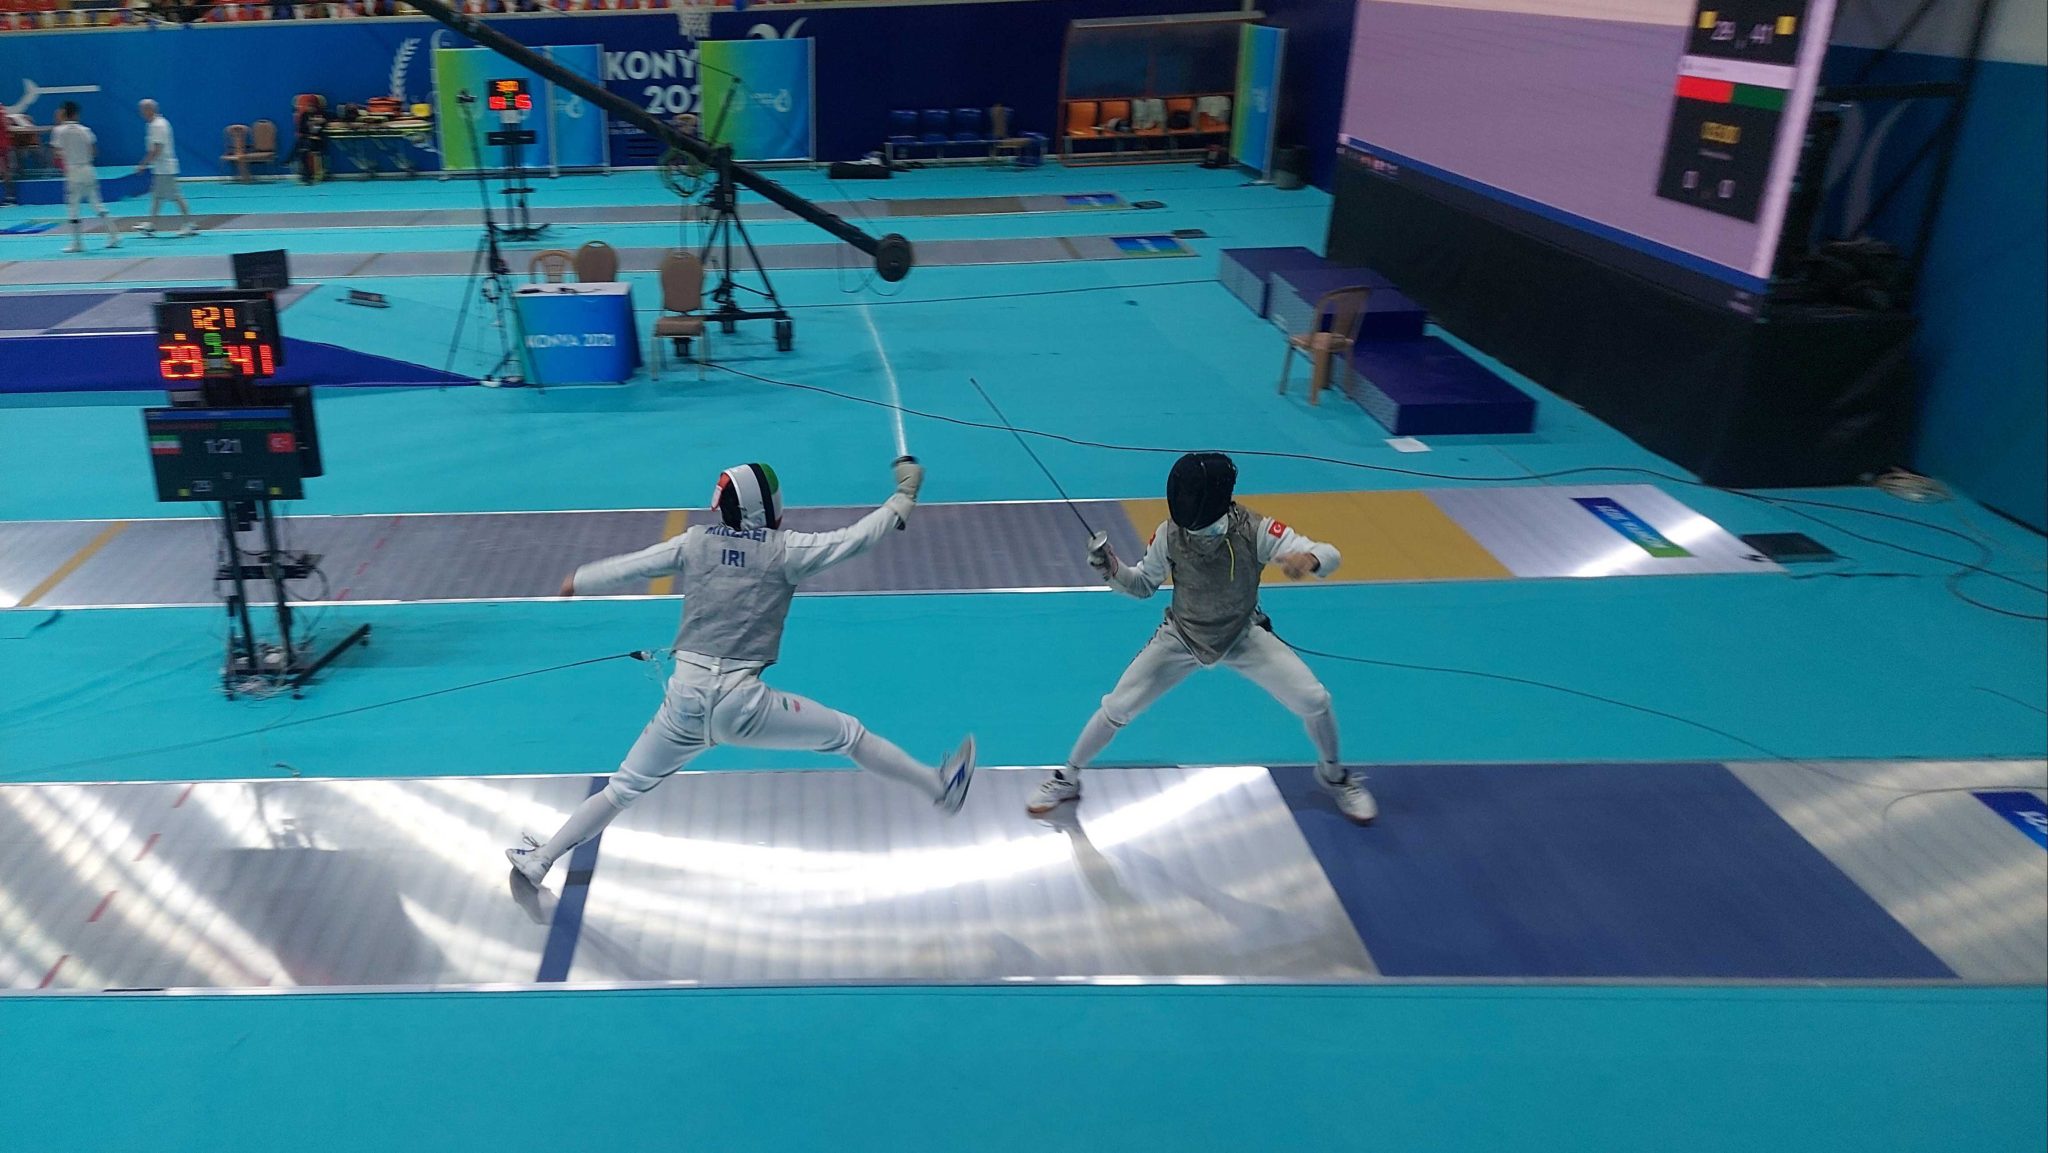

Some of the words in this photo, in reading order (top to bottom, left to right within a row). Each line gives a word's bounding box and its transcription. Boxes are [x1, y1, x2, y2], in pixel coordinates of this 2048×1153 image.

[604, 49, 699, 80] KONY
[642, 85, 703, 114] 202
[224, 345, 274, 375] 41
[721, 548, 745, 568] IRI
